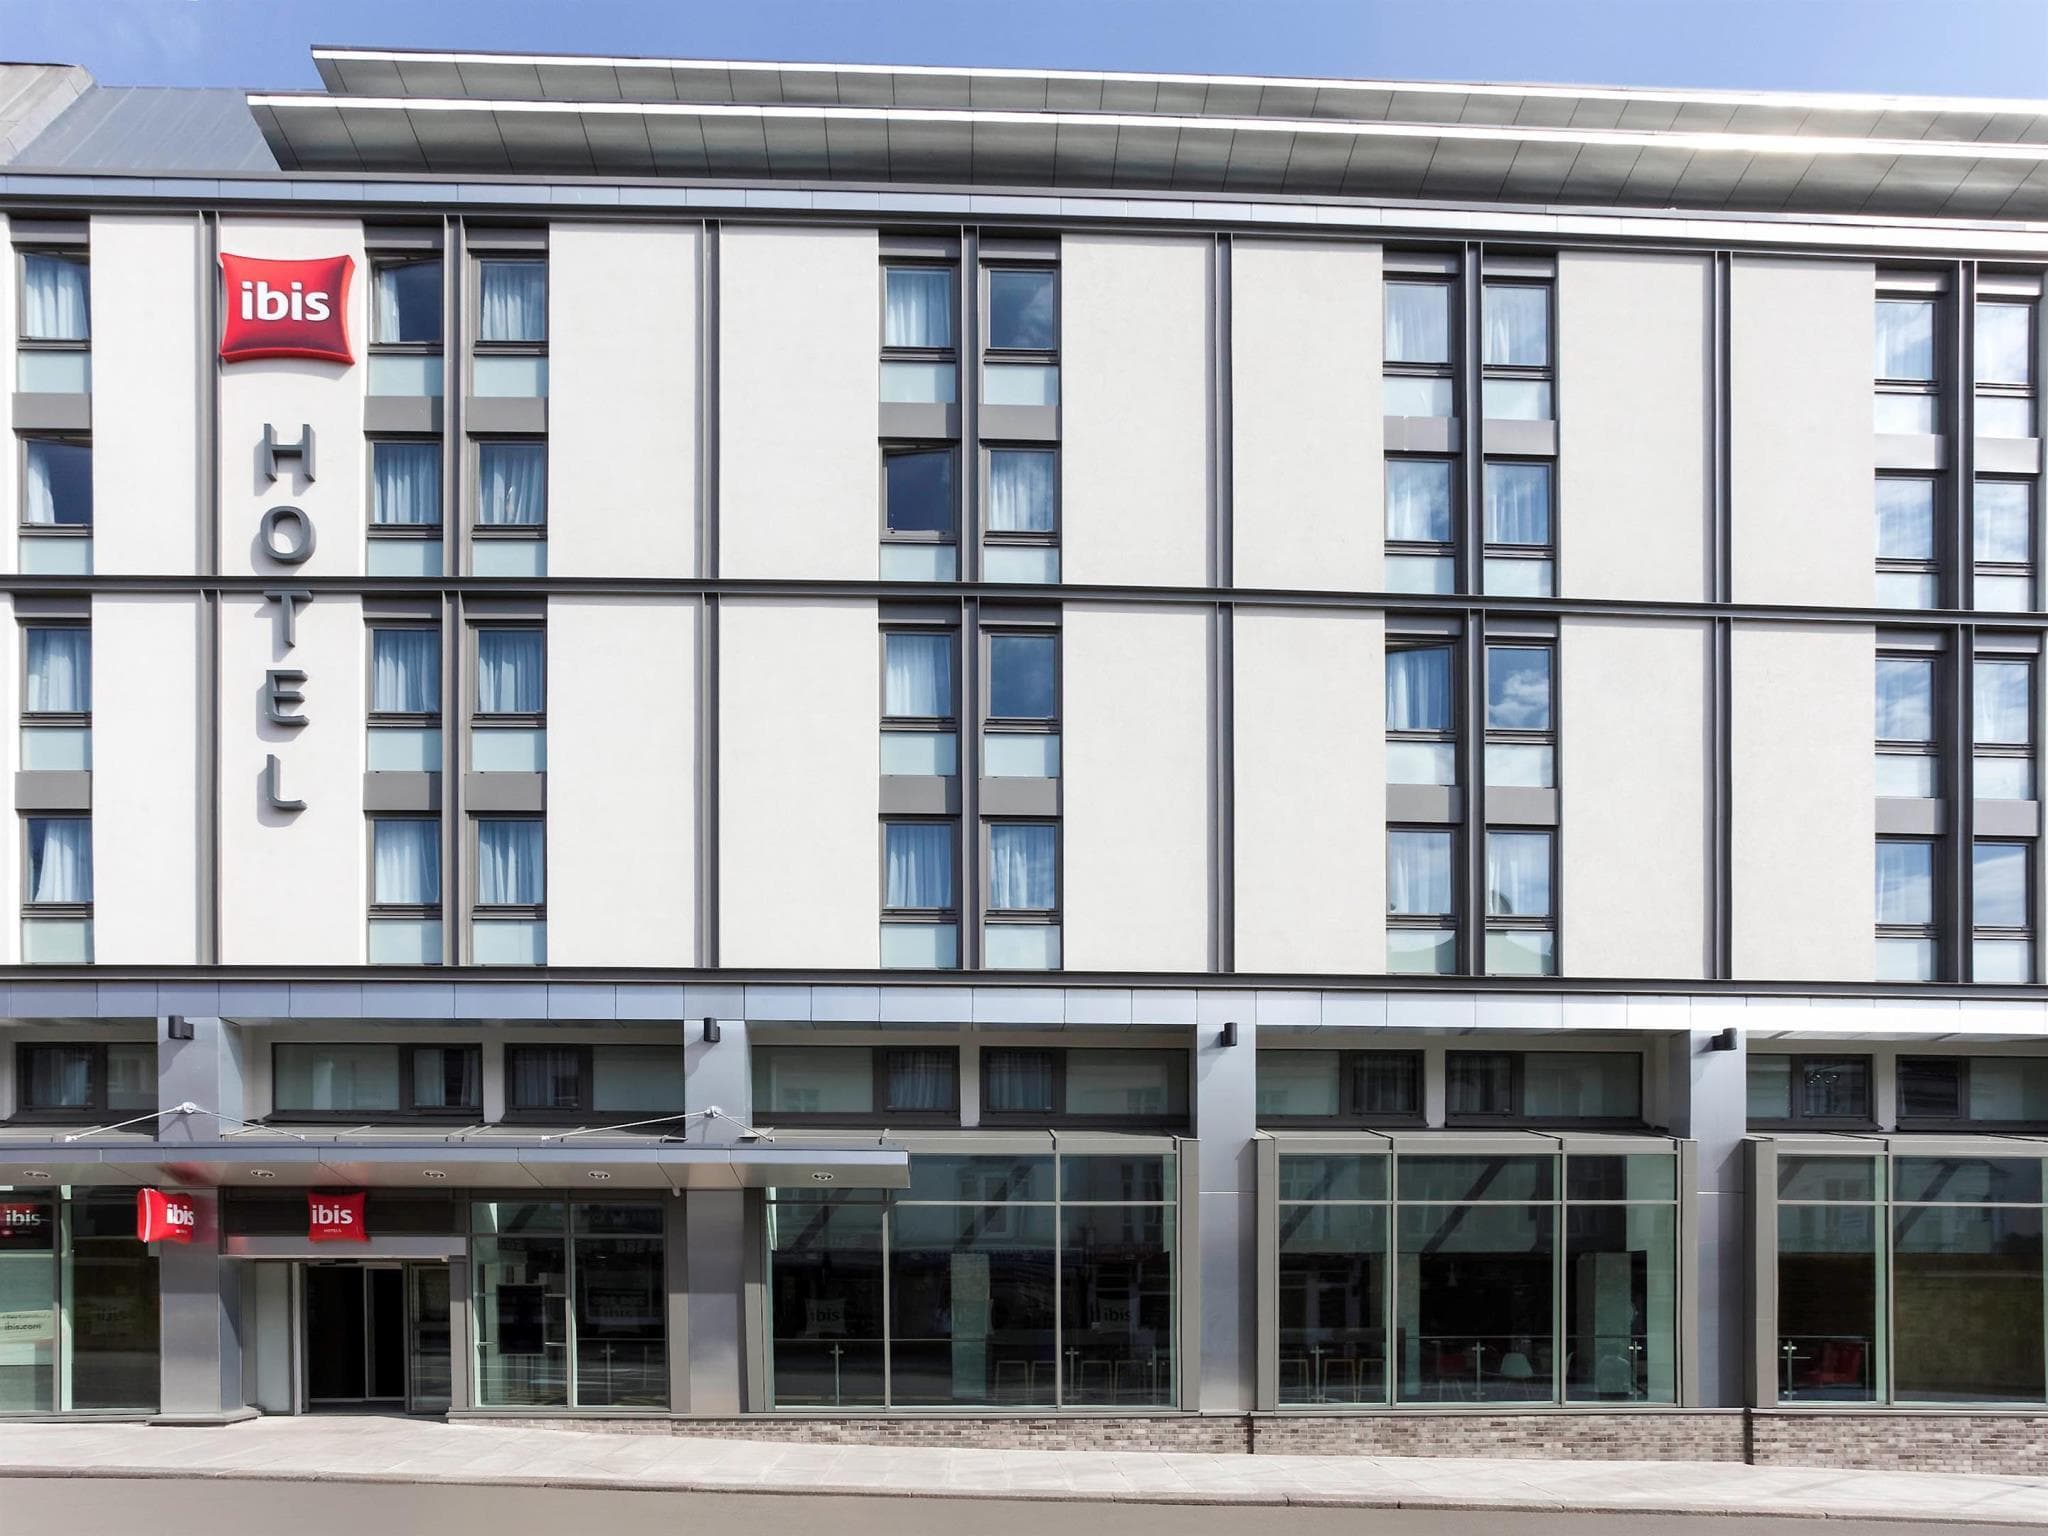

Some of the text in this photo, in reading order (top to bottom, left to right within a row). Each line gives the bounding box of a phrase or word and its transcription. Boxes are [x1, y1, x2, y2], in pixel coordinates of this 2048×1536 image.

[241, 281, 331, 321] ibis
[260, 423, 317, 811] HOTEL
[6, 1210, 41, 1226] ibis
[166, 1203, 194, 1226] ibis
[312, 1204, 353, 1225] ibis
